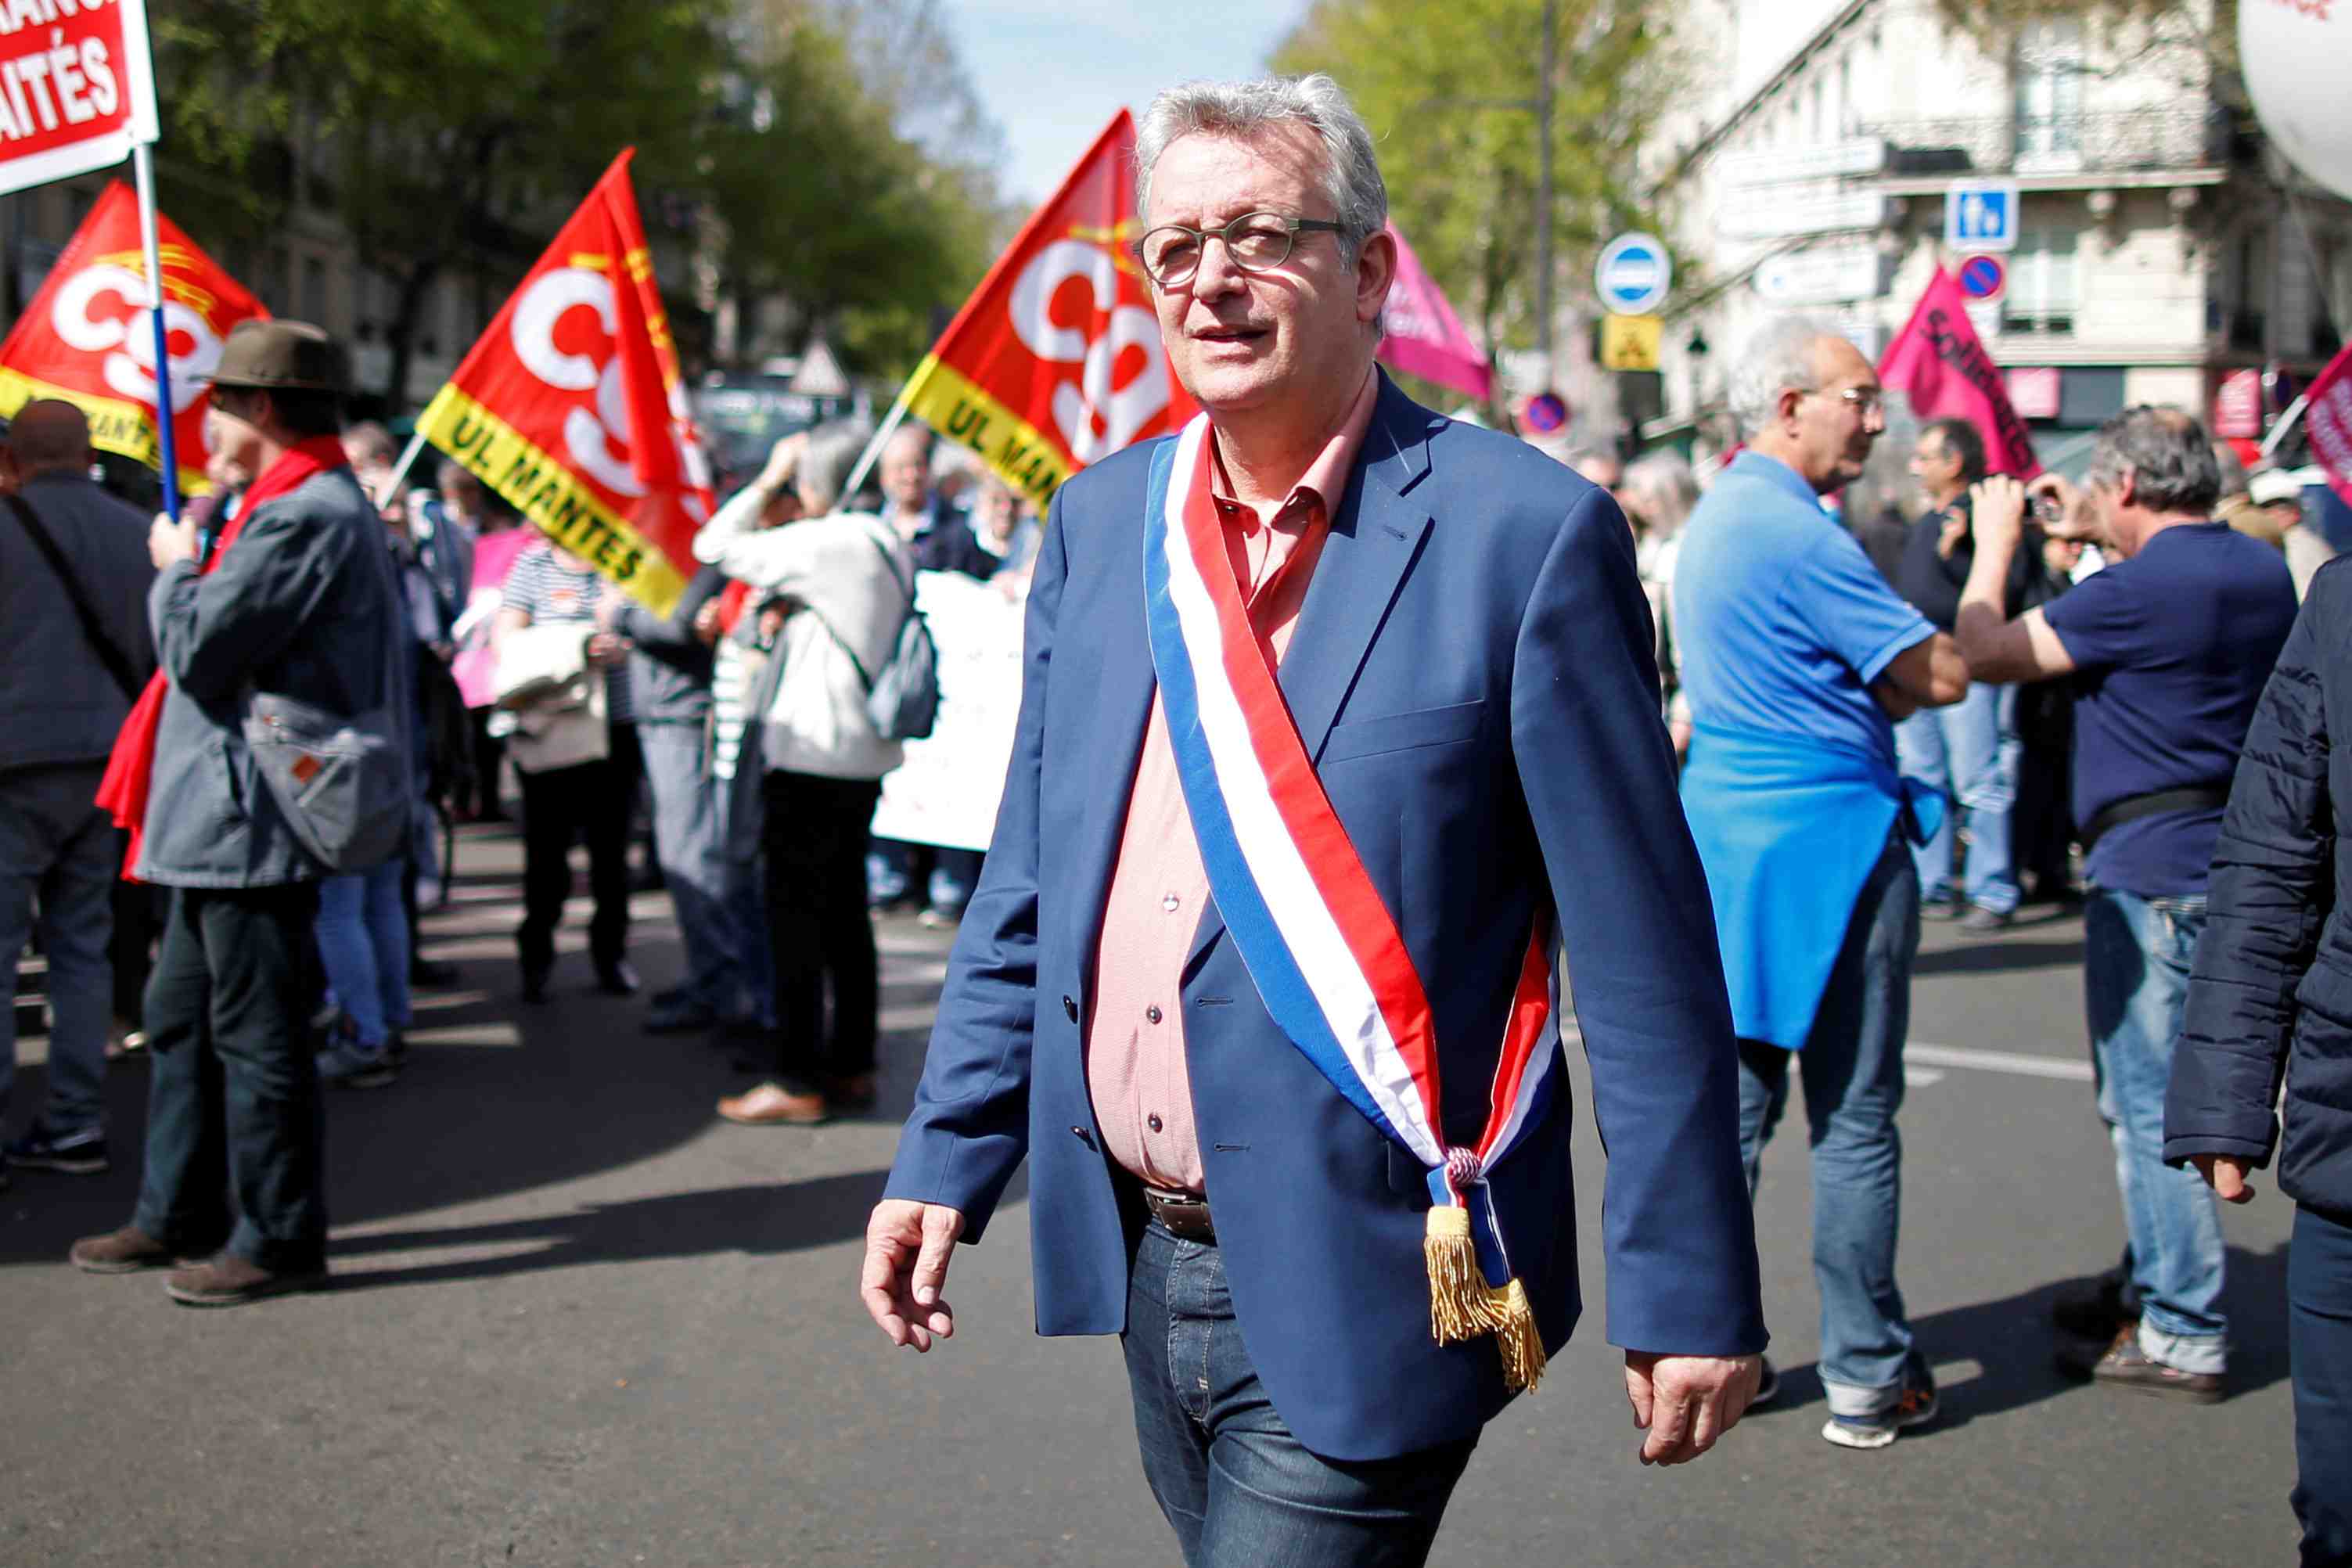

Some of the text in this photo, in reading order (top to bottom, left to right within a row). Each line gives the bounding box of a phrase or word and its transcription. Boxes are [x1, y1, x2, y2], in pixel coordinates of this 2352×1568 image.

[947, 399, 990, 453] UL
[451, 416, 645, 581] UL MANTES
